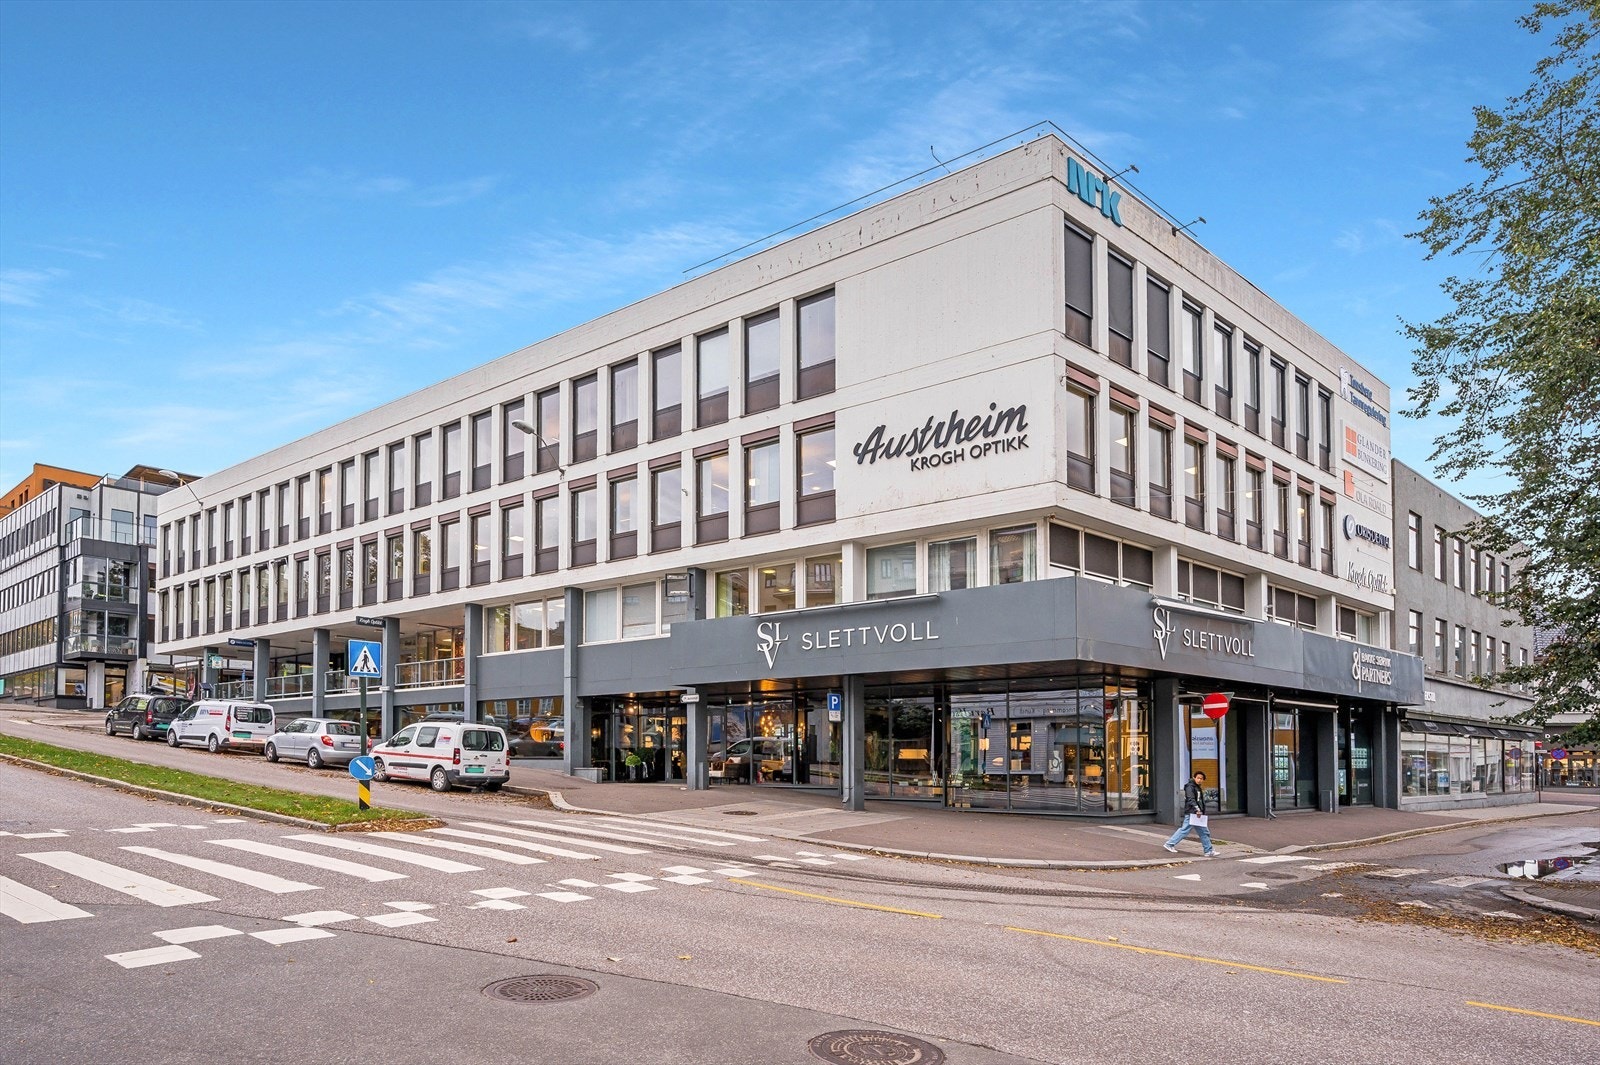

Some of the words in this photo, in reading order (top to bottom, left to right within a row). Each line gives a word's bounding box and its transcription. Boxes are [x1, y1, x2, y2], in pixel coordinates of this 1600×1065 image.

[853, 402, 1029, 465] Austrheim
[1357, 433, 1387, 460] GLANDER
[910, 447, 965, 471] KROGH
[970, 434, 1030, 459] OPTIKK
[1357, 448, 1388, 475] BUNKERING
[1355, 490, 1368, 506] OLA
[801, 620, 939, 651] SLETTVOLL
[1183, 630, 1255, 657] SLETTVOLL
[1362, 666, 1392, 686] PARTNERS
